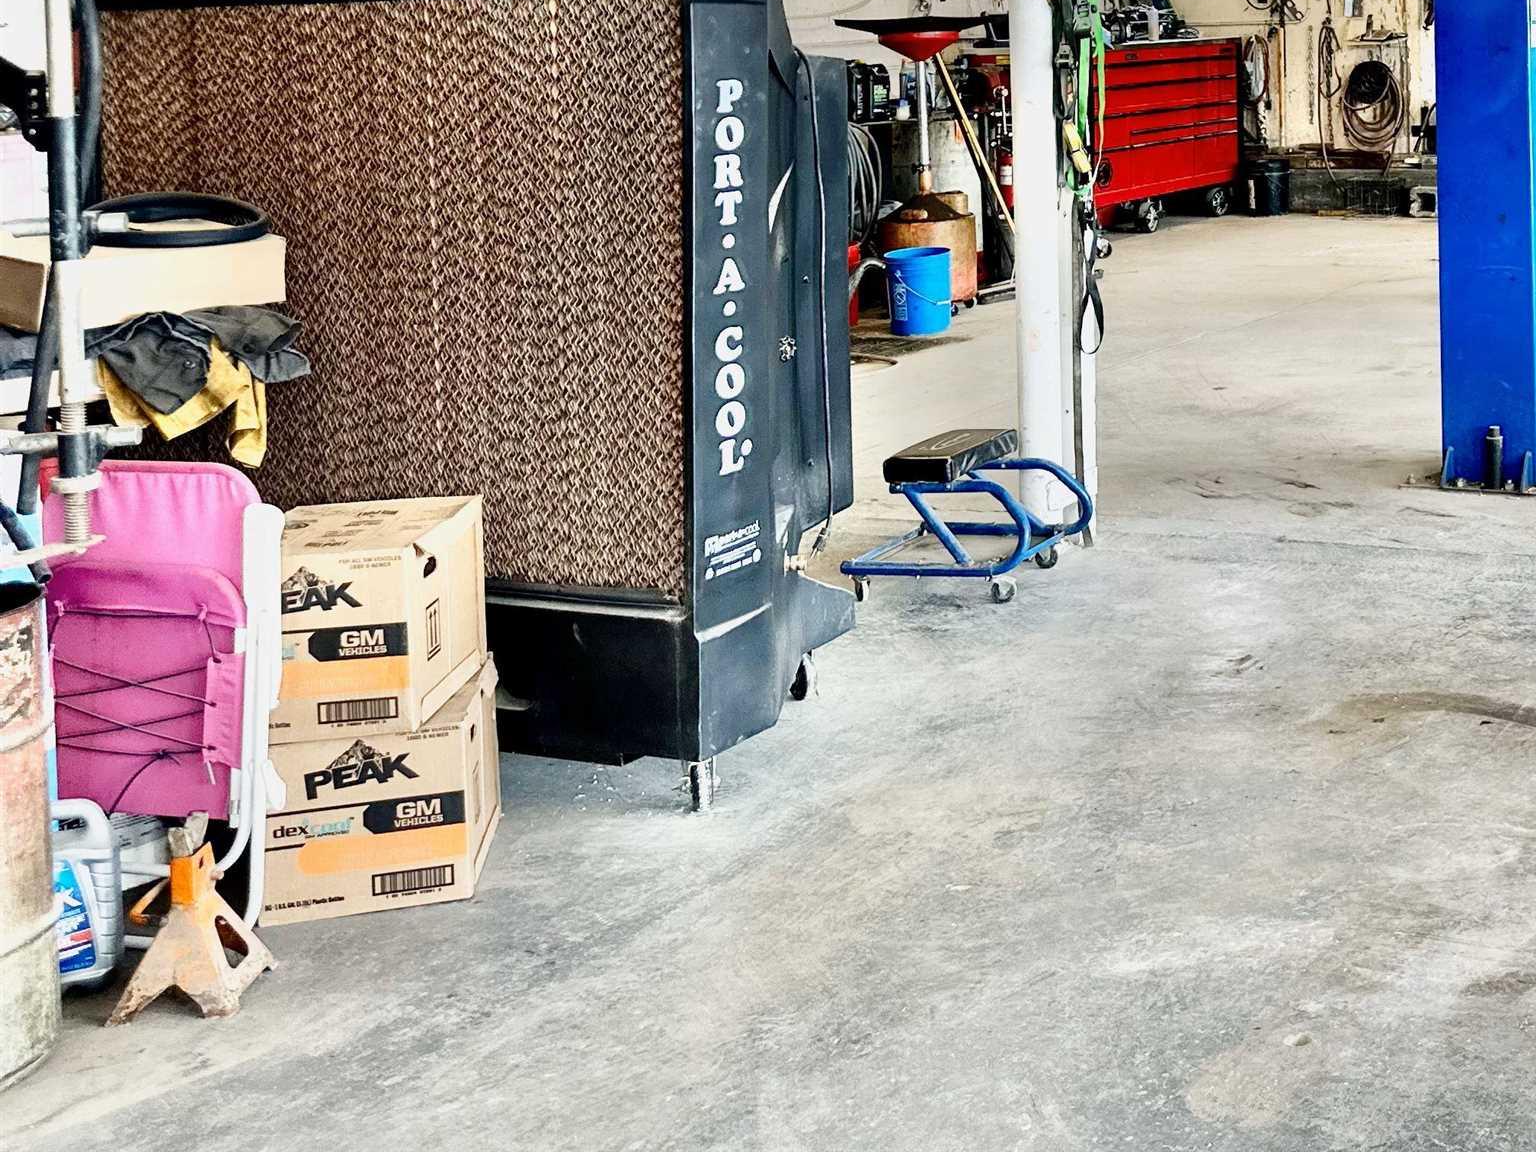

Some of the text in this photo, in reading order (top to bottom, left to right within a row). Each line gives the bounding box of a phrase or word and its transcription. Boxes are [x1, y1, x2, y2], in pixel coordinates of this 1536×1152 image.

[281, 581, 364, 615] EAK
[340, 629, 385, 648] GM
[339, 646, 388, 657] VEHICLES
[304, 752, 420, 801] PEAK
[396, 798, 442, 819] GM
[394, 814, 444, 828] VEHICLES
